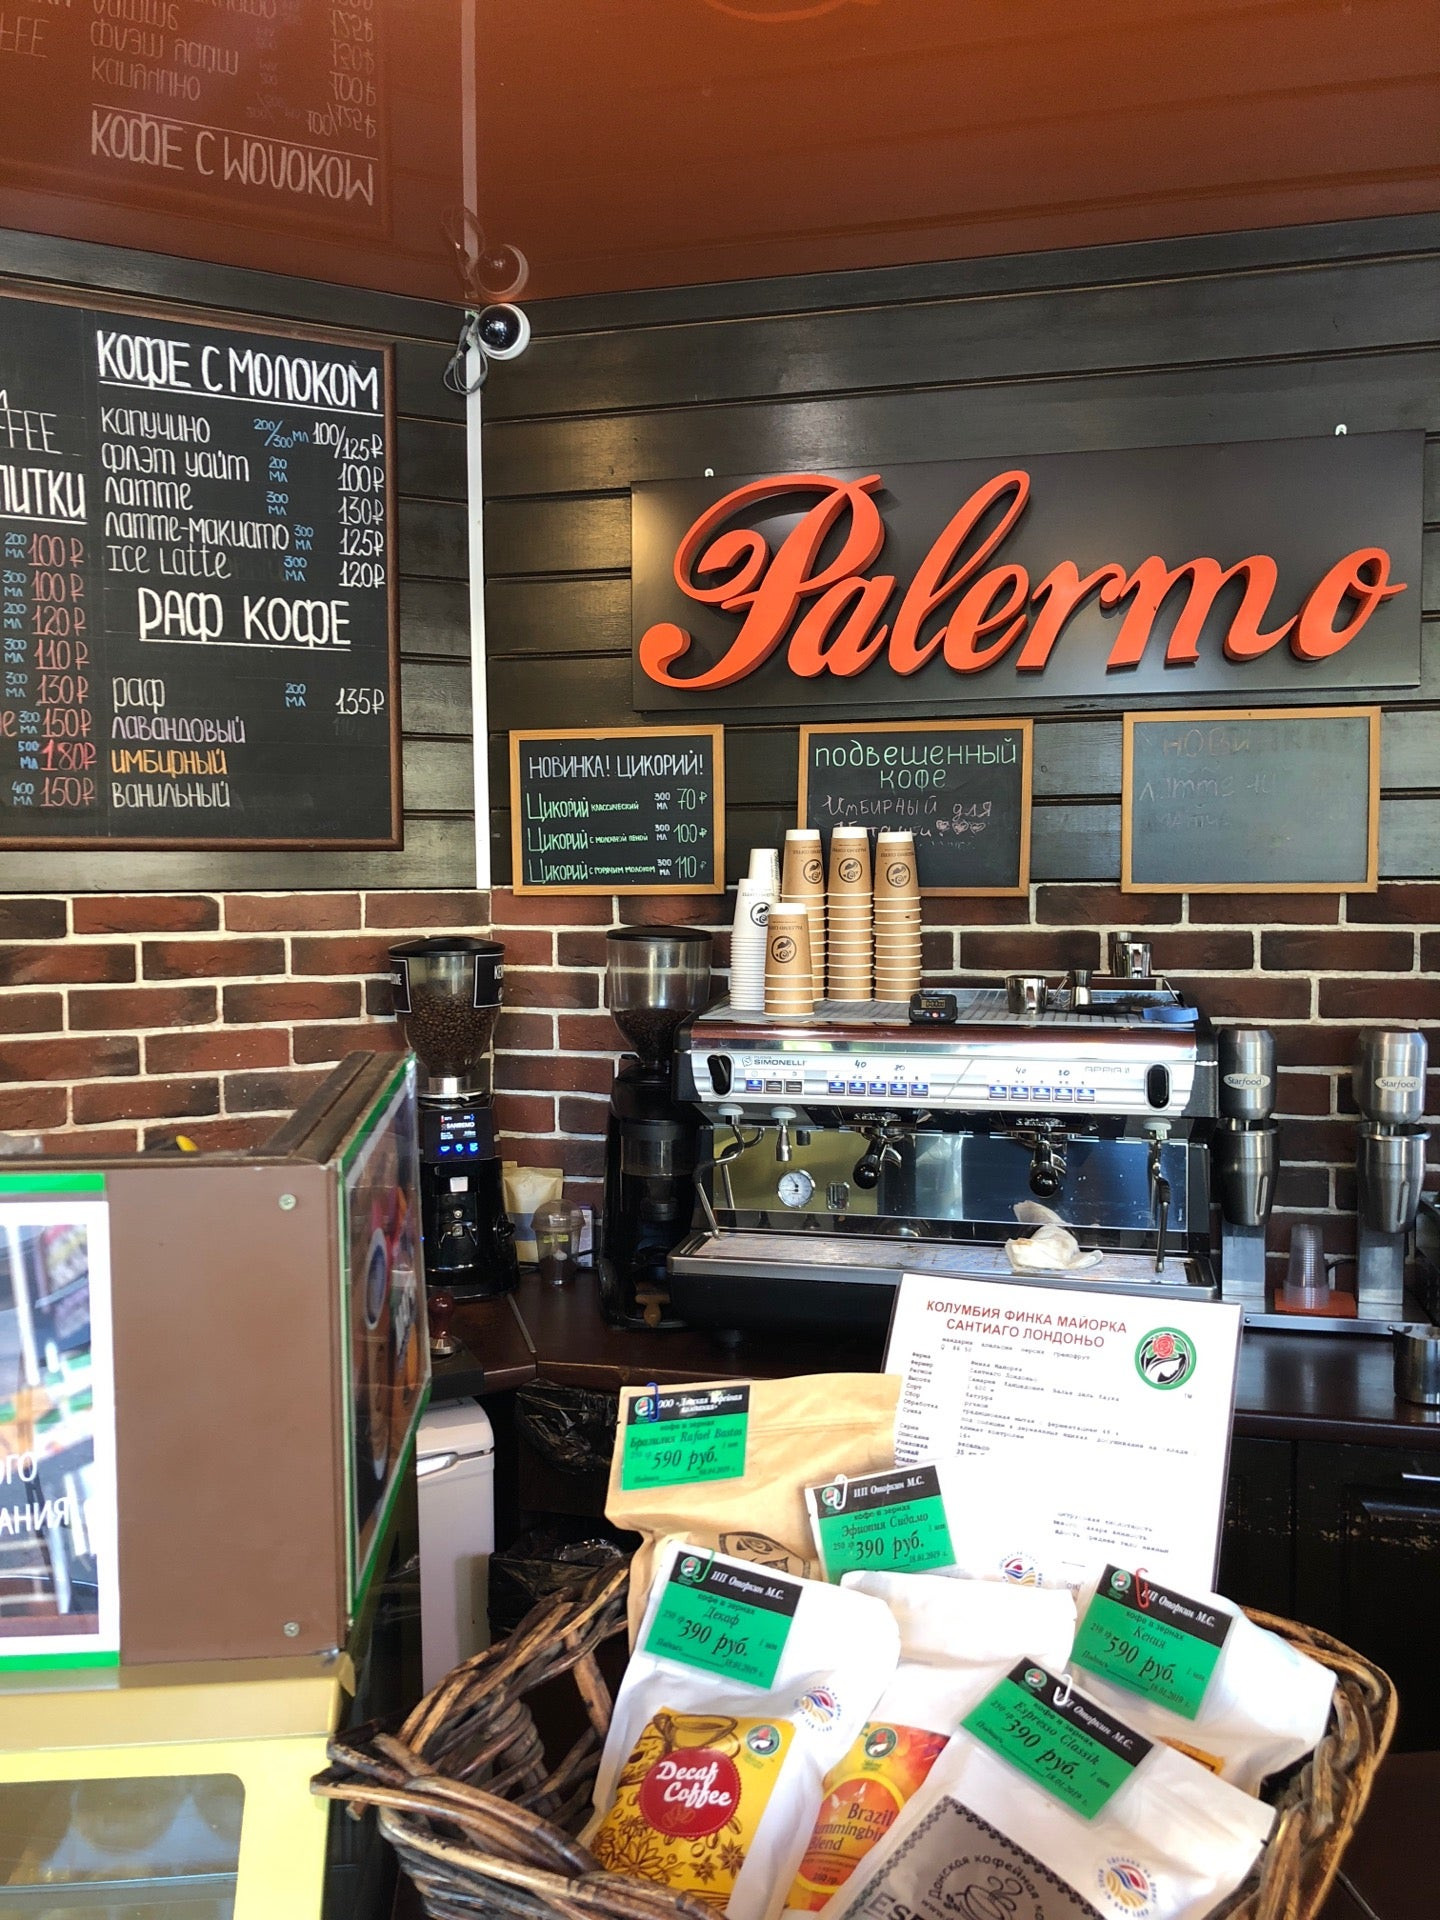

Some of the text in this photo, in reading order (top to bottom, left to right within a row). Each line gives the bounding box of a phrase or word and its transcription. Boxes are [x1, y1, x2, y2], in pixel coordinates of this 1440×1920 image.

[97, 330, 379, 410] КОФЕ С МОЛОКОМ
[101, 406, 210, 443] капучино
[101, 443, 177, 475] флэт
[105, 476, 193, 511] латте
[28, 533, 66, 567] 100
[31, 570, 66, 602] 100
[639, 469, 1408, 691] Palermo
[31, 605, 71, 637] 120
[138, 588, 352, 648] РАФ КОФЕ
[34, 639, 72, 671] 110
[112, 676, 166, 714] раф
[111, 715, 246, 744] лавандовый
[18, 741, 40, 752] 500
[815, 737, 1017, 768] подвешенный
[528, 749, 704, 780] НОВИНКА! ЦИКОРИЙ!
[880, 768, 946, 791] кофе
[1227, 1075, 1262, 1087] Starfood
[1380, 1078, 1417, 1089] Starfood
[925, 1300, 1127, 1334] КОЛУМБИЯ ФИНКА МАЙОРКА
[946, 1317, 1105, 1348] САНТИАГО ЛОНДОНЬО
[654, 1449, 681, 1468] 590
[856, 1537, 884, 1560] 390
[680, 1619, 711, 1643] 390
[703, 1606, 739, 1627] Декаф
[1106, 1634, 1138, 1663] 590
[1132, 1625, 1165, 1648] Кения
[1008, 1716, 1040, 1747] 390
[1013, 1702, 1099, 1765] Espresso Classik
[656, 1760, 719, 1786] Decaf
[663, 1781, 732, 1808] Coffee
[847, 1803, 896, 1826] Brazil
